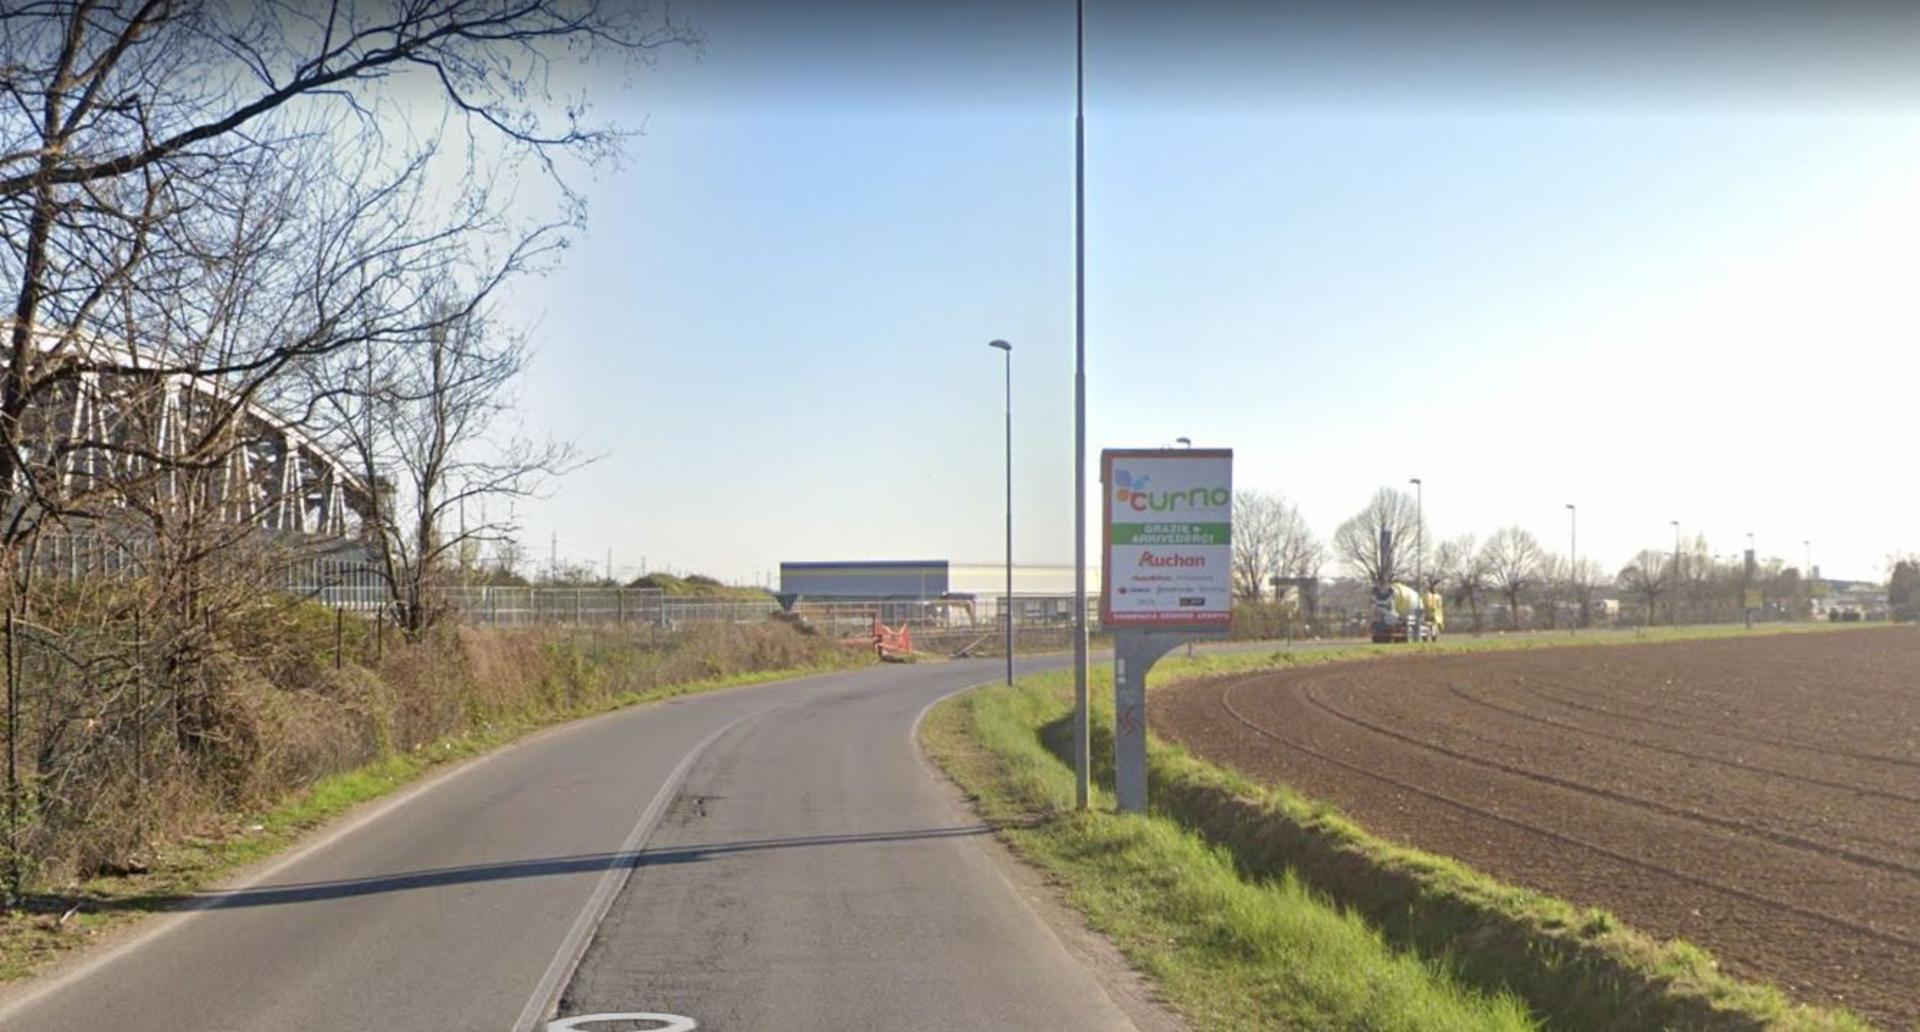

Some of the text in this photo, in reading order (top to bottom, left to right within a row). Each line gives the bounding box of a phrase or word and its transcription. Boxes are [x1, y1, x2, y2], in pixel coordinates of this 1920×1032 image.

[1129, 486, 1229, 512] curno
[1143, 524, 1189, 534] GRAZIE
[1131, 534, 1214, 544] ARRIVEDERCI
[1138, 550, 1206, 567] Auchan
